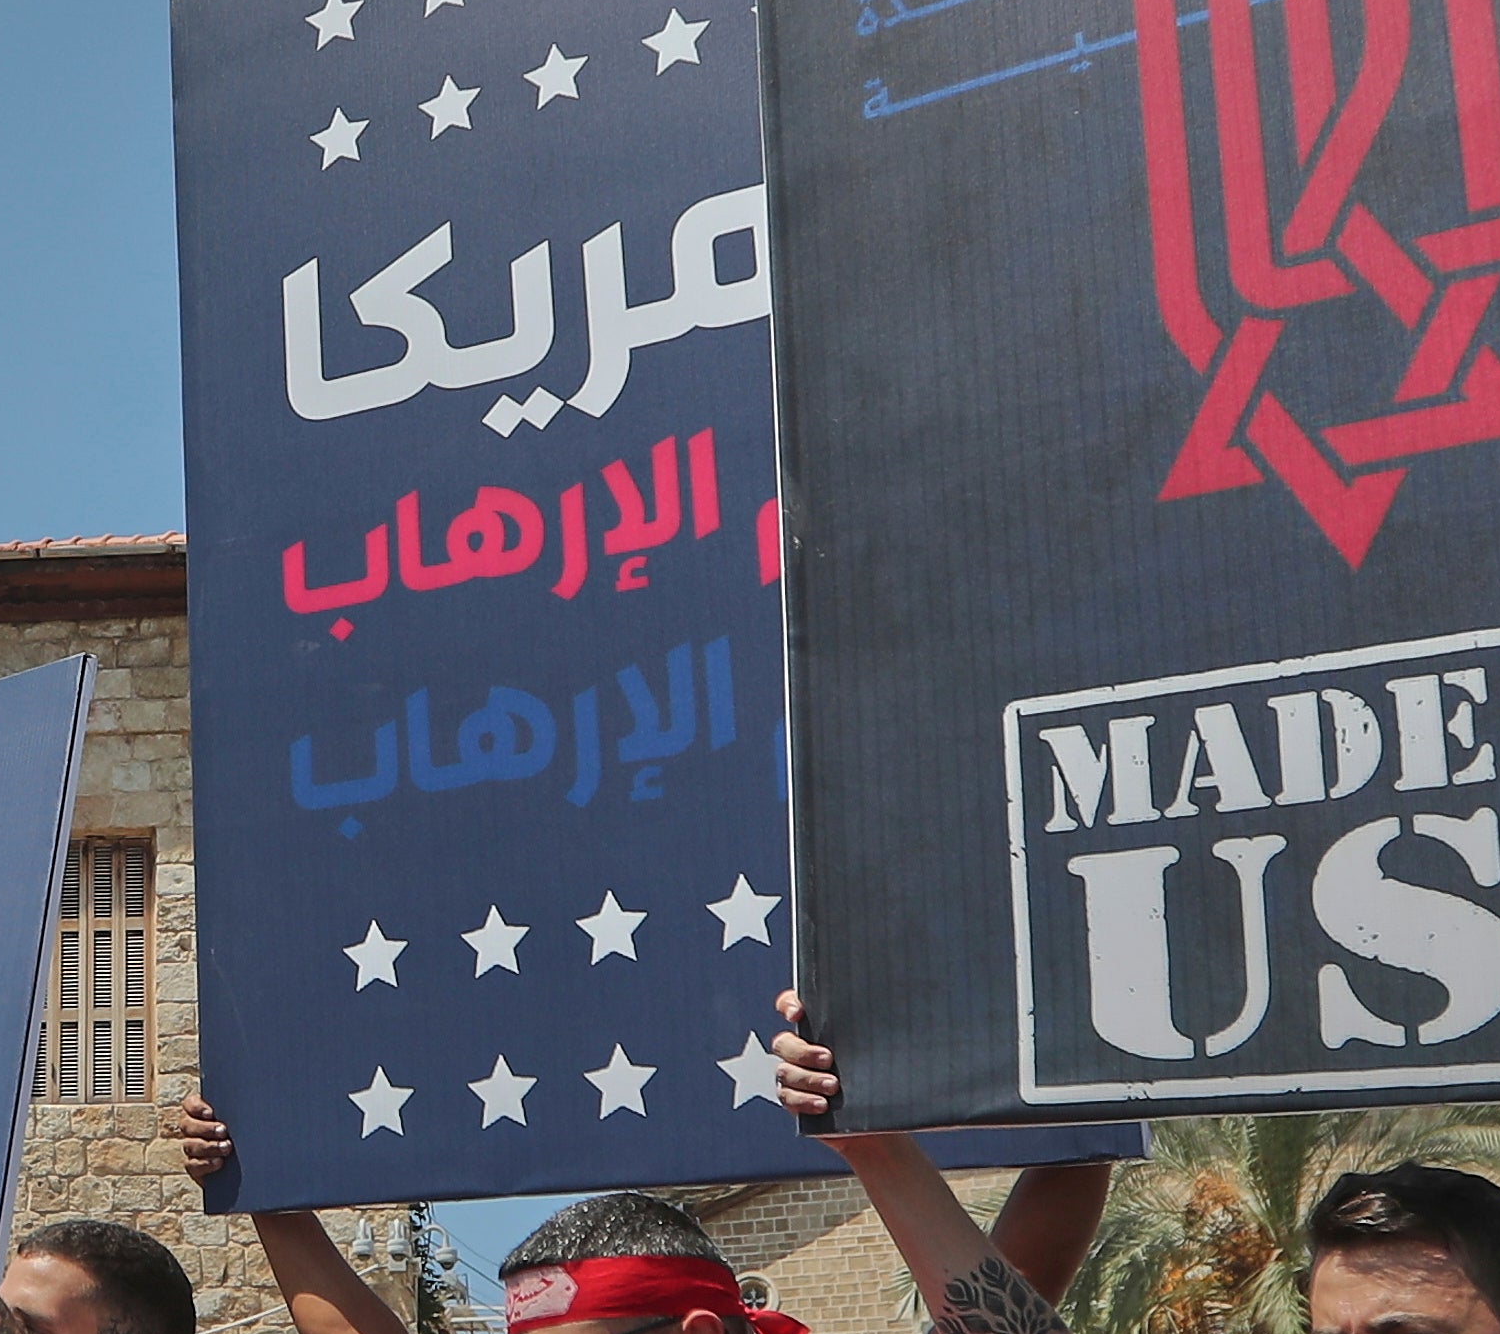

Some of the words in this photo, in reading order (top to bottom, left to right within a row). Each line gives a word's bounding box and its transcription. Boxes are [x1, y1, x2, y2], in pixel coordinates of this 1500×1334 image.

[282, 180, 771, 438] مريكا
[282, 425, 720, 643] الإرهاب
[290, 634, 736, 839] الإرهاب
[1041, 670, 1497, 833] MADE
